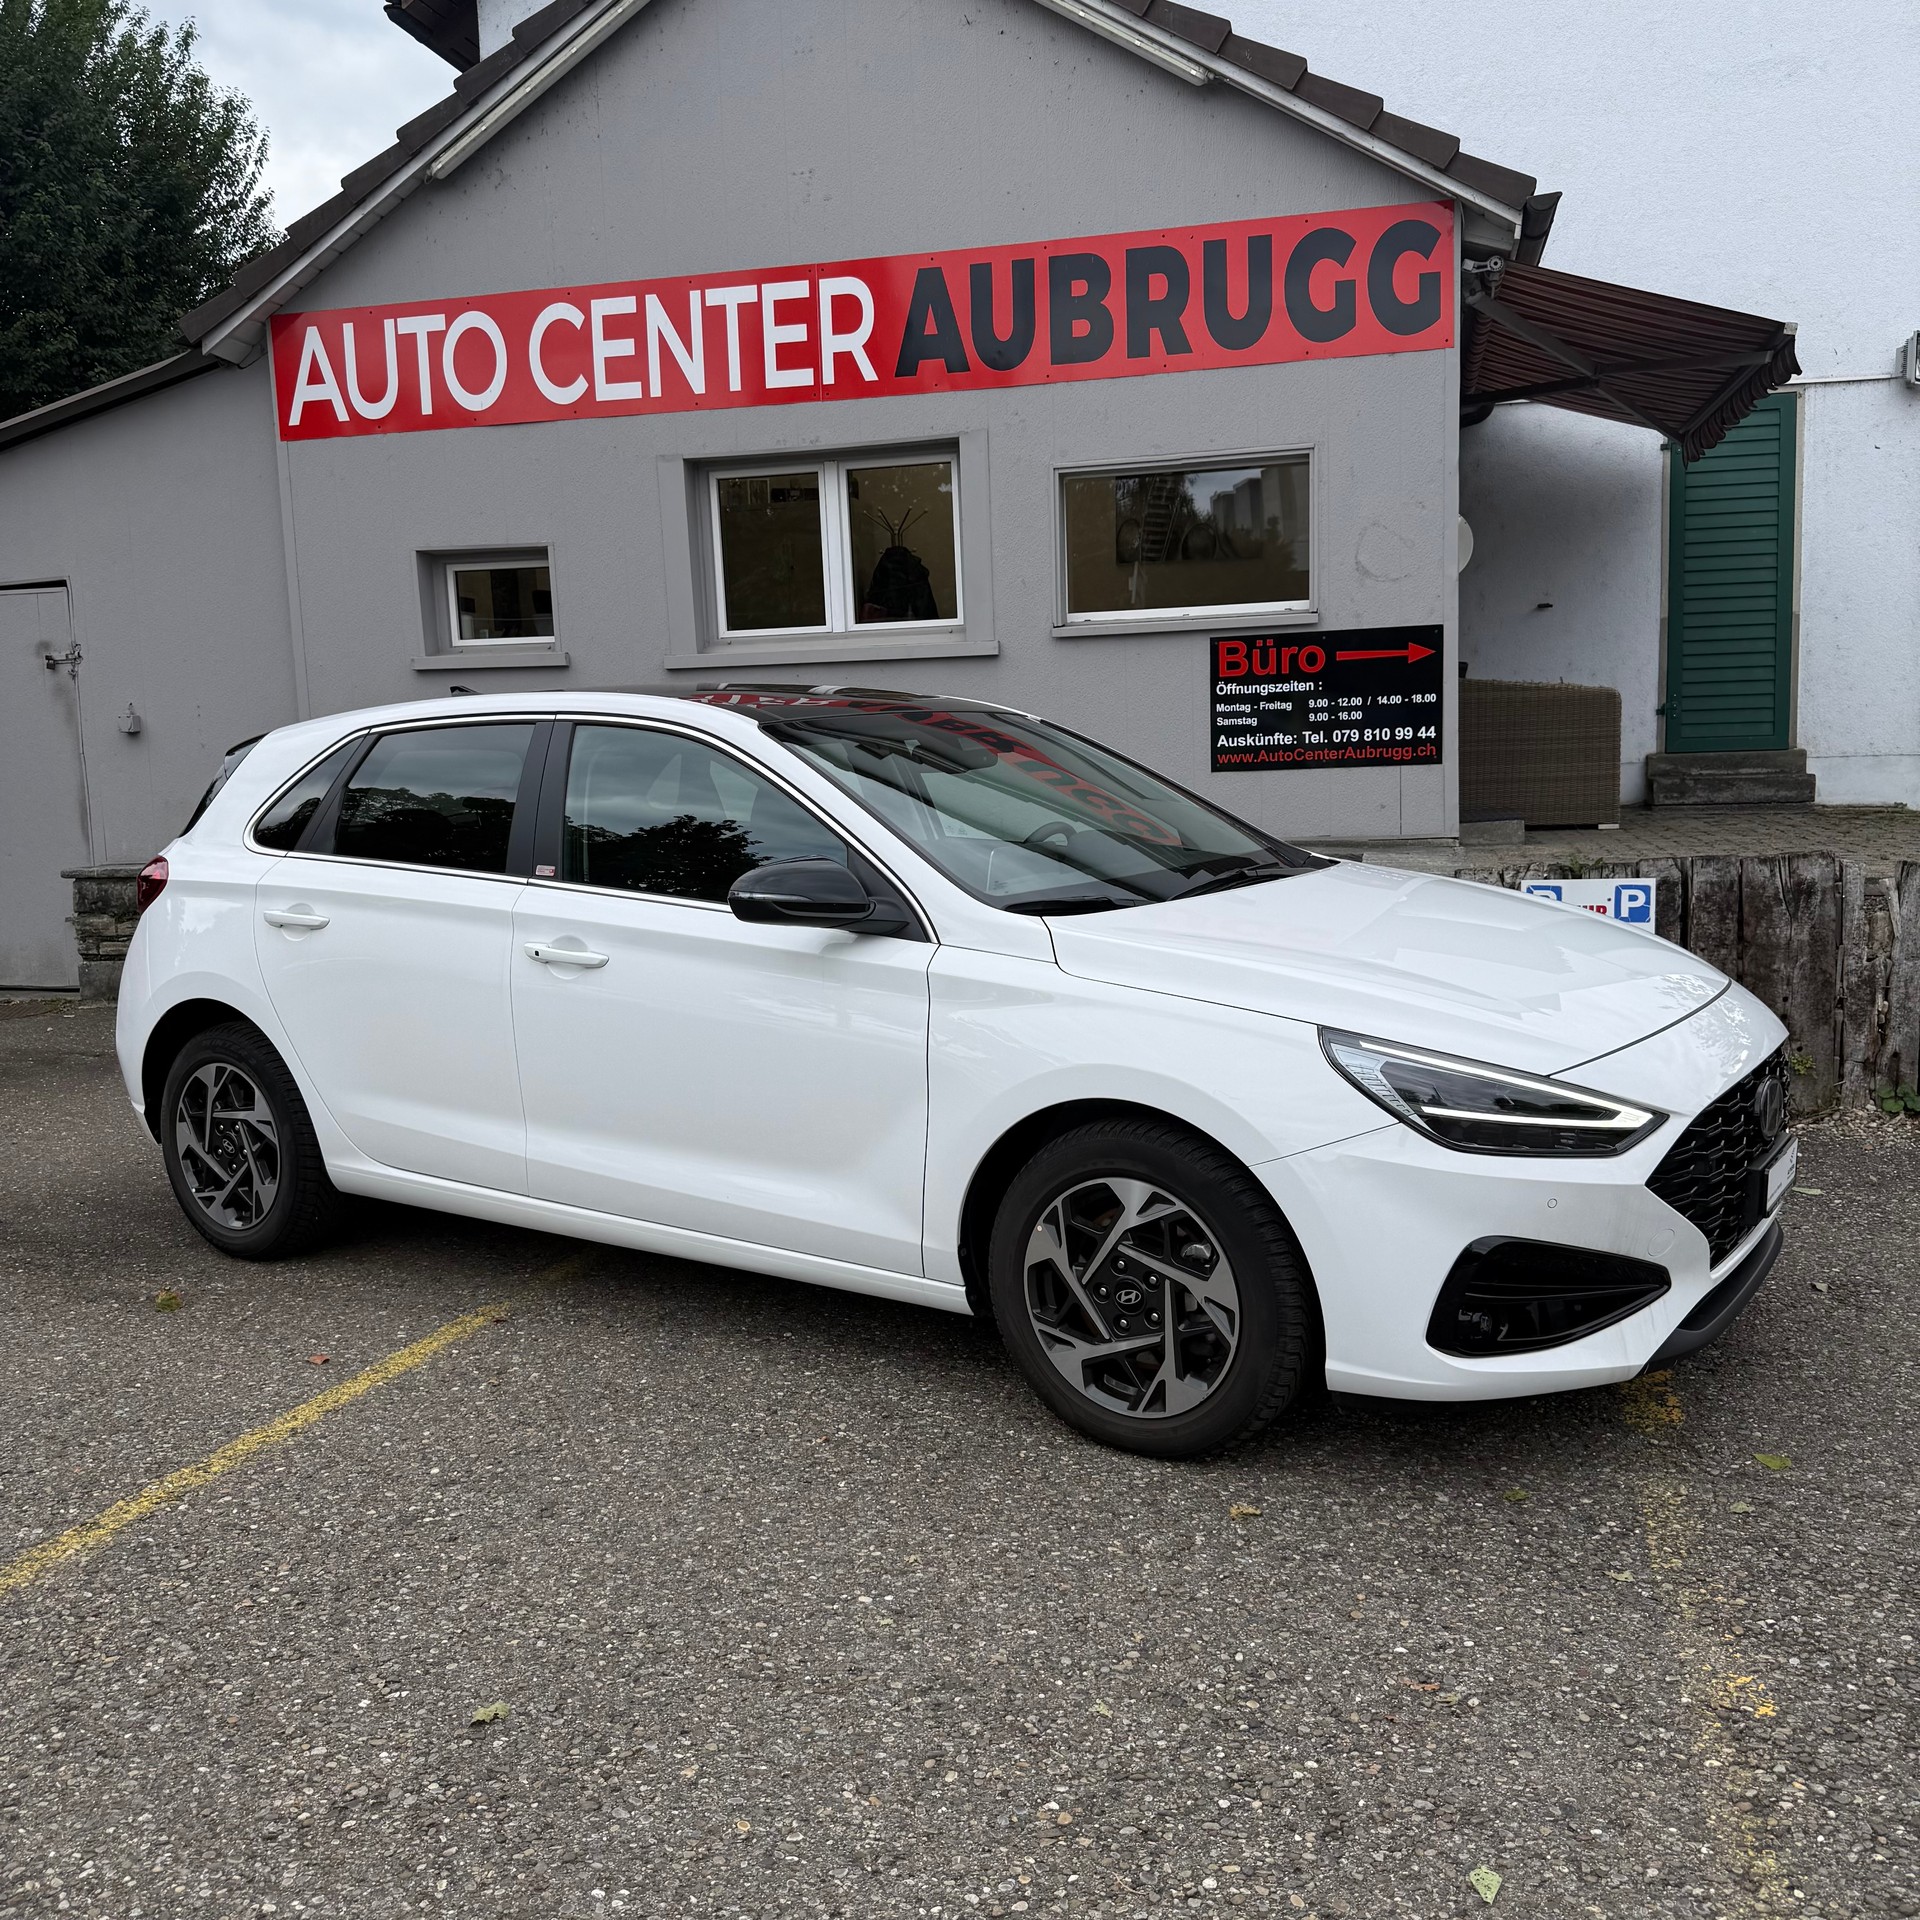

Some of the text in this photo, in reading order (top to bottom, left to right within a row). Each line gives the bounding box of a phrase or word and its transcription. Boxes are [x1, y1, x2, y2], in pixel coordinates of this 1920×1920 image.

[288, 218, 1442, 427] AUTO CENTER AUBRUGG
[1217, 638, 1326, 677] Büro
[1215, 680, 1315, 696] Öffnungszeiten
[1216, 703, 1251, 713] Montag
[1259, 700, 1293, 711] Freitag
[1308, 698, 1329, 708] 9.00
[1337, 697, 1363, 707] 12.00
[1376, 695, 1402, 705] 14.00
[1411, 693, 1437, 703] 18.00
[1216, 716, 1258, 727] Samstag
[1308, 712, 1329, 722] 9.00
[1337, 710, 1363, 720] 16.00
[1216, 725, 1437, 748] Auskünfte: Tel. 079 810 99 44
[1216, 742, 1437, 764] www.AutoCenterAubrugg.ch
[1620, 889, 1647, 918] P
